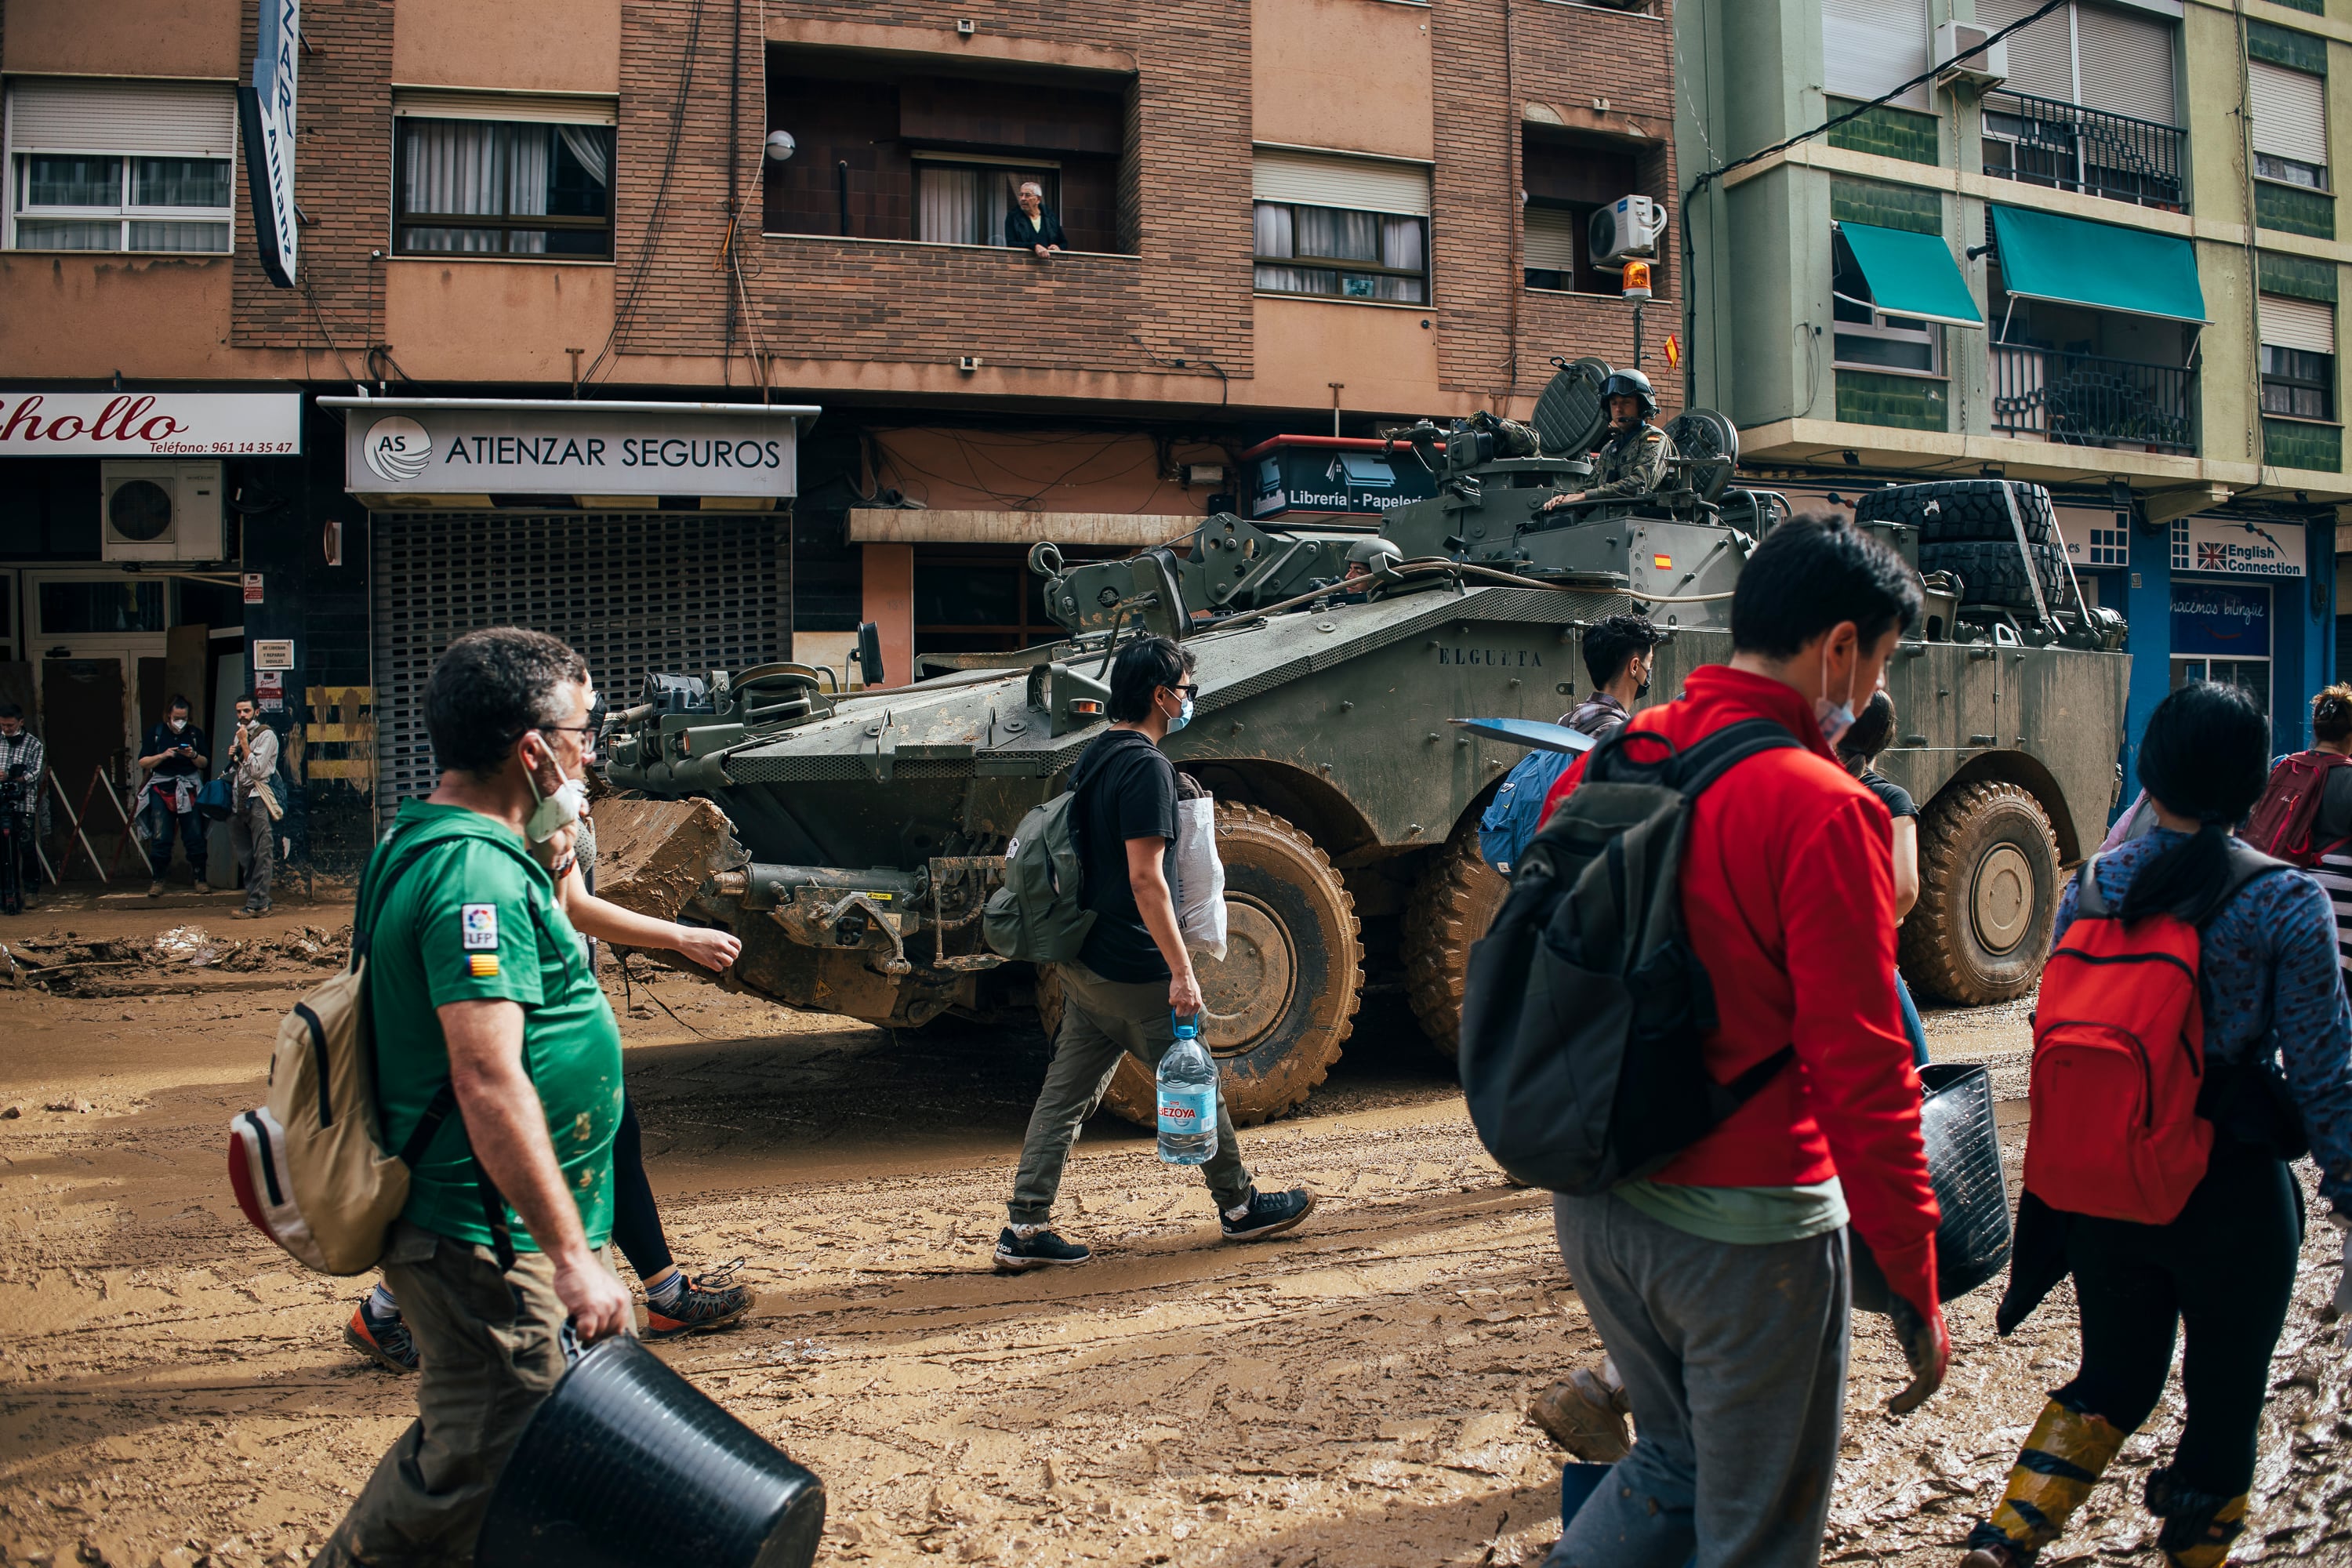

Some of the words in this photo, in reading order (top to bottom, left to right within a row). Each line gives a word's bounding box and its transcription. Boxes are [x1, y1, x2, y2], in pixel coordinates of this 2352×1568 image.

[268, 126, 290, 263] Allianz
[0, 395, 189, 441] hollo
[150, 441, 208, 455] Teléfono:
[212, 442, 234, 452] 961
[238, 442, 253, 452] 14
[257, 442, 273, 452] 35
[276, 442, 292, 452] 47
[379, 436, 406, 452] AS
[445, 435, 606, 466] ATIENZAR
[621, 438, 780, 469] SEGUROS
[1290, 490, 1347, 506] Librería
[1363, 493, 1428, 510] Papele
[2228, 544, 2274, 560] English
[2227, 560, 2300, 575] Connection
[2224, 598, 2264, 626] bilingüe
[1439, 648, 1542, 666] ELGUETA
[467, 933, 492, 944] LFP
[1159, 1107, 1196, 1118] BEZOYA
